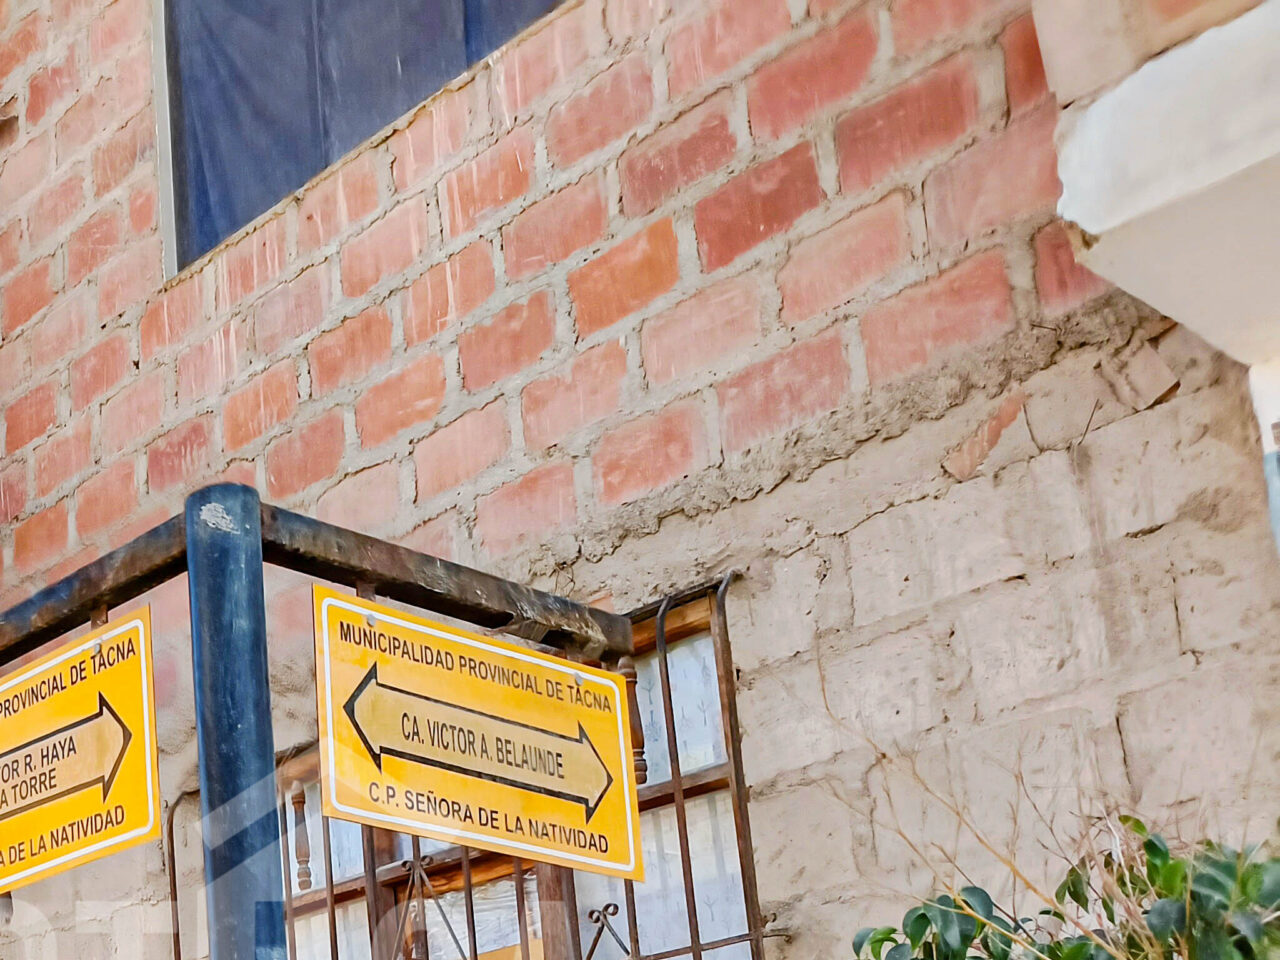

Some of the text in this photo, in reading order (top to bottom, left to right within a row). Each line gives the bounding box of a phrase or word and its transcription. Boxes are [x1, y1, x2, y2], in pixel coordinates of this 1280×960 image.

[70, 660, 87, 686] DE
[90, 638, 136, 675] TACNA
[340, 621, 612, 713] MUNICIPALIDAD PROVINCIAL DE TACNA
[24, 754, 37, 773] R.
[40, 736, 77, 766] HAYA
[402, 712, 565, 779] CA. VICTOR A. BELAUNDE
[11, 768, 57, 805] TORRE
[9, 841, 26, 865] DE
[30, 834, 48, 859] LA
[50, 805, 125, 850] NATIVIDAD
[404, 790, 472, 823] SEÑORA
[479, 808, 499, 830] DE
[504, 813, 525, 834] LA
[528, 819, 609, 854] NATIVIDAD
